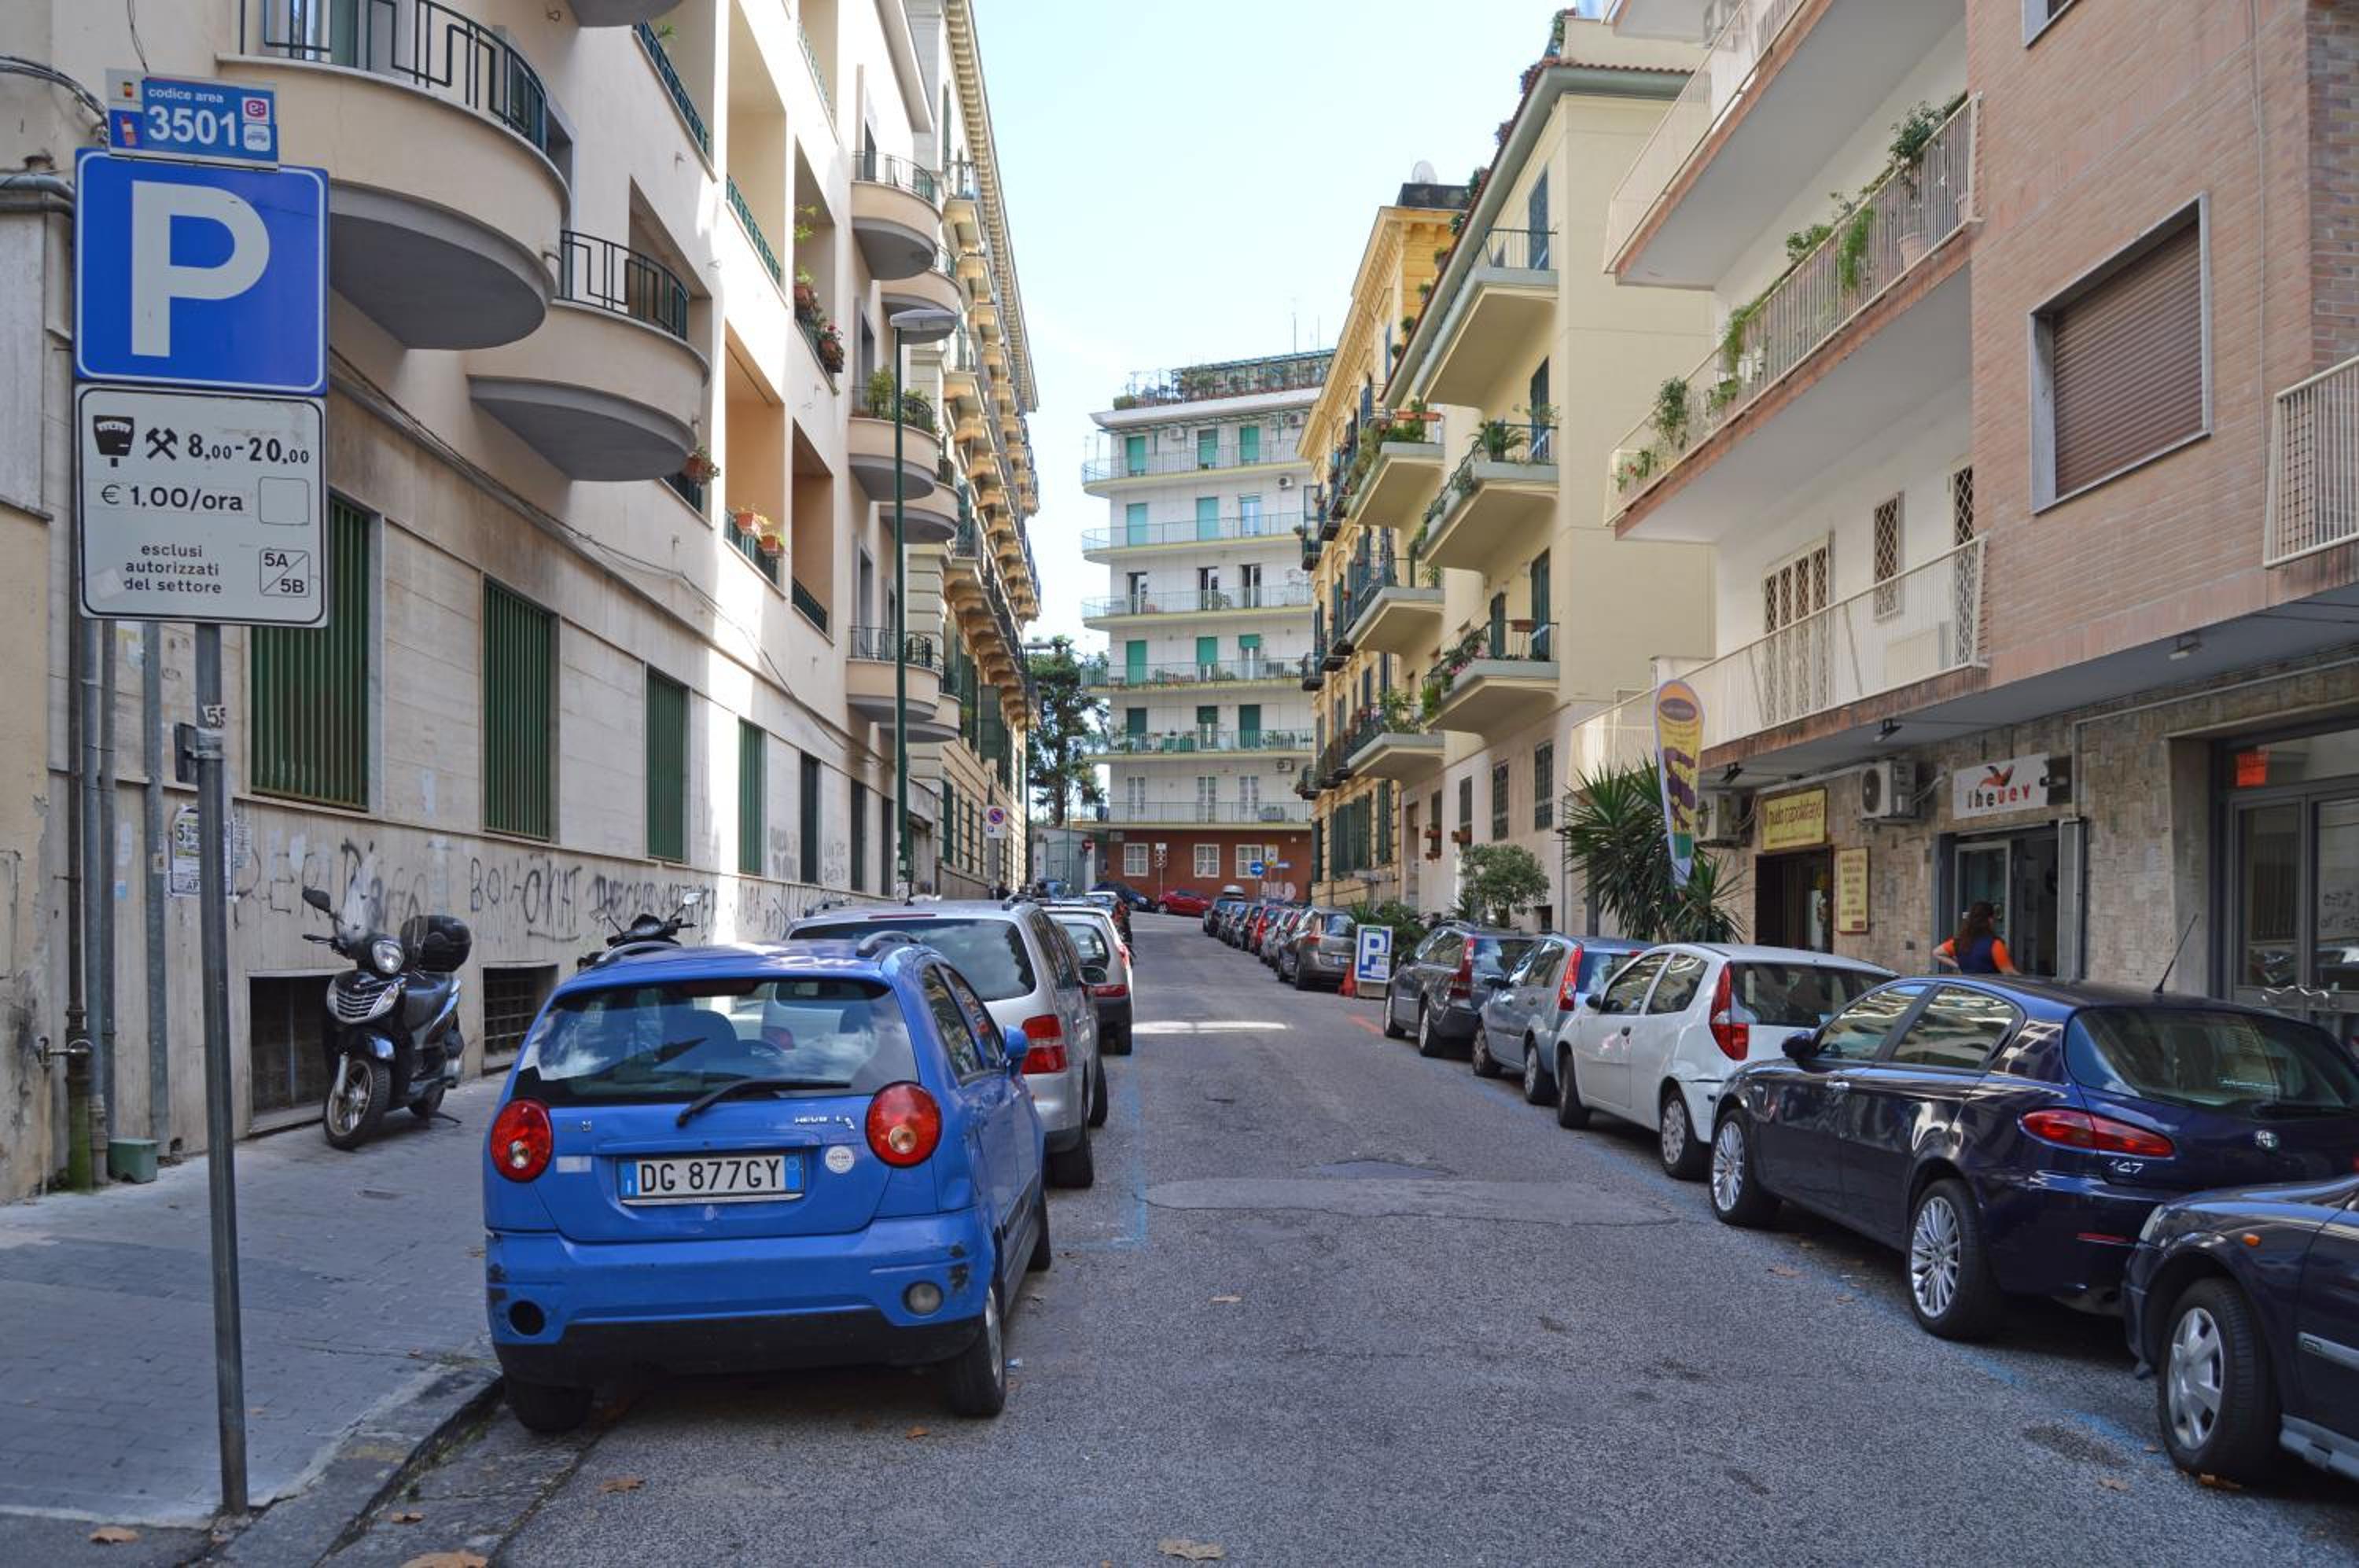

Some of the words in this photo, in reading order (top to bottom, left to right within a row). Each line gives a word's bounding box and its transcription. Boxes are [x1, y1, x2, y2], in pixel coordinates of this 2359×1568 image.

[148, 87, 192, 100] codice
[195, 91, 224, 104] area
[148, 104, 236, 147] 3501
[131, 179, 270, 359] P
[130, 485, 244, 512] 1.00/ora
[141, 543, 203, 558] esclusi
[263, 551, 289, 568] 5A
[125, 561, 219, 576] autorizzati
[123, 576, 151, 591] del
[156, 579, 223, 594] settore
[280, 578, 305, 594] 5B
[1362, 931, 1386, 966] P
[640, 1162, 676, 1194] DG
[687, 1158, 782, 1191] 877GY
